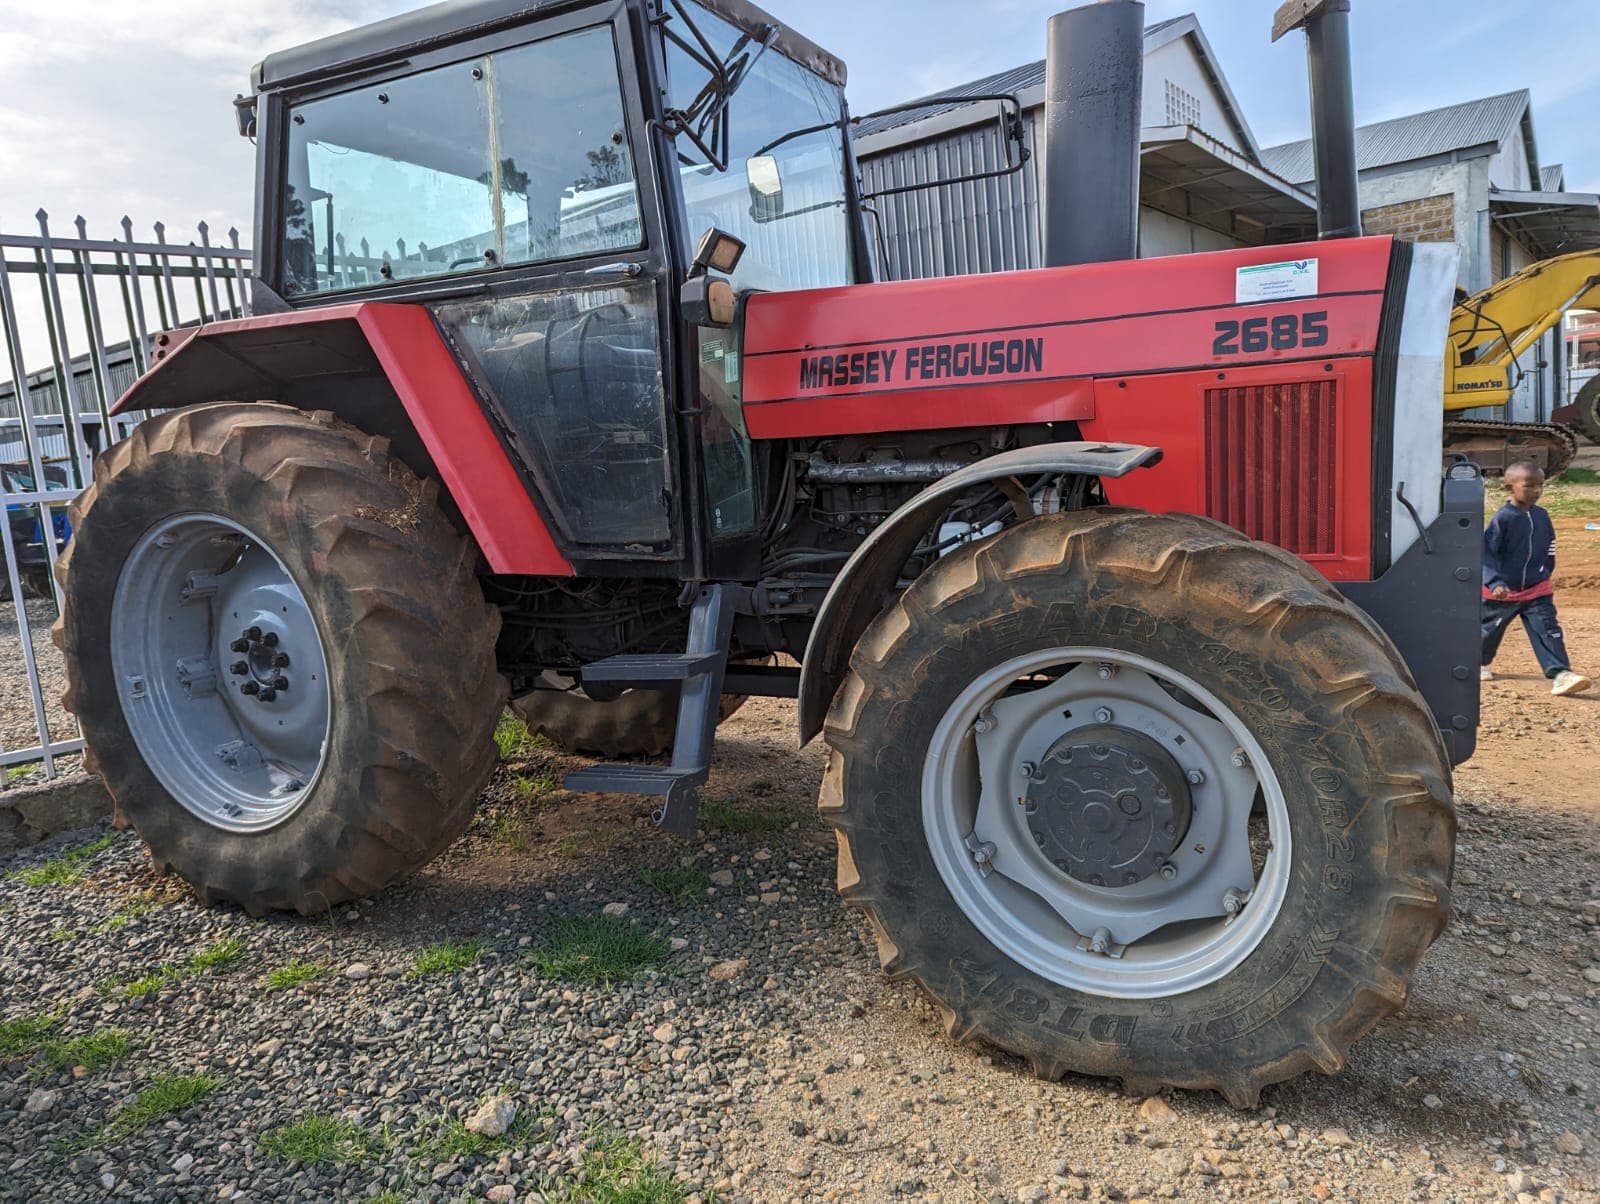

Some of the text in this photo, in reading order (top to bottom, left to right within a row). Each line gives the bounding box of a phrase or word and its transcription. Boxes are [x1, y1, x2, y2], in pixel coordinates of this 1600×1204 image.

[1212, 311, 1329, 356] 2685
[799, 337, 1044, 389] MASSEY FERGUSON
[1456, 380, 1503, 390] KOMATSU
